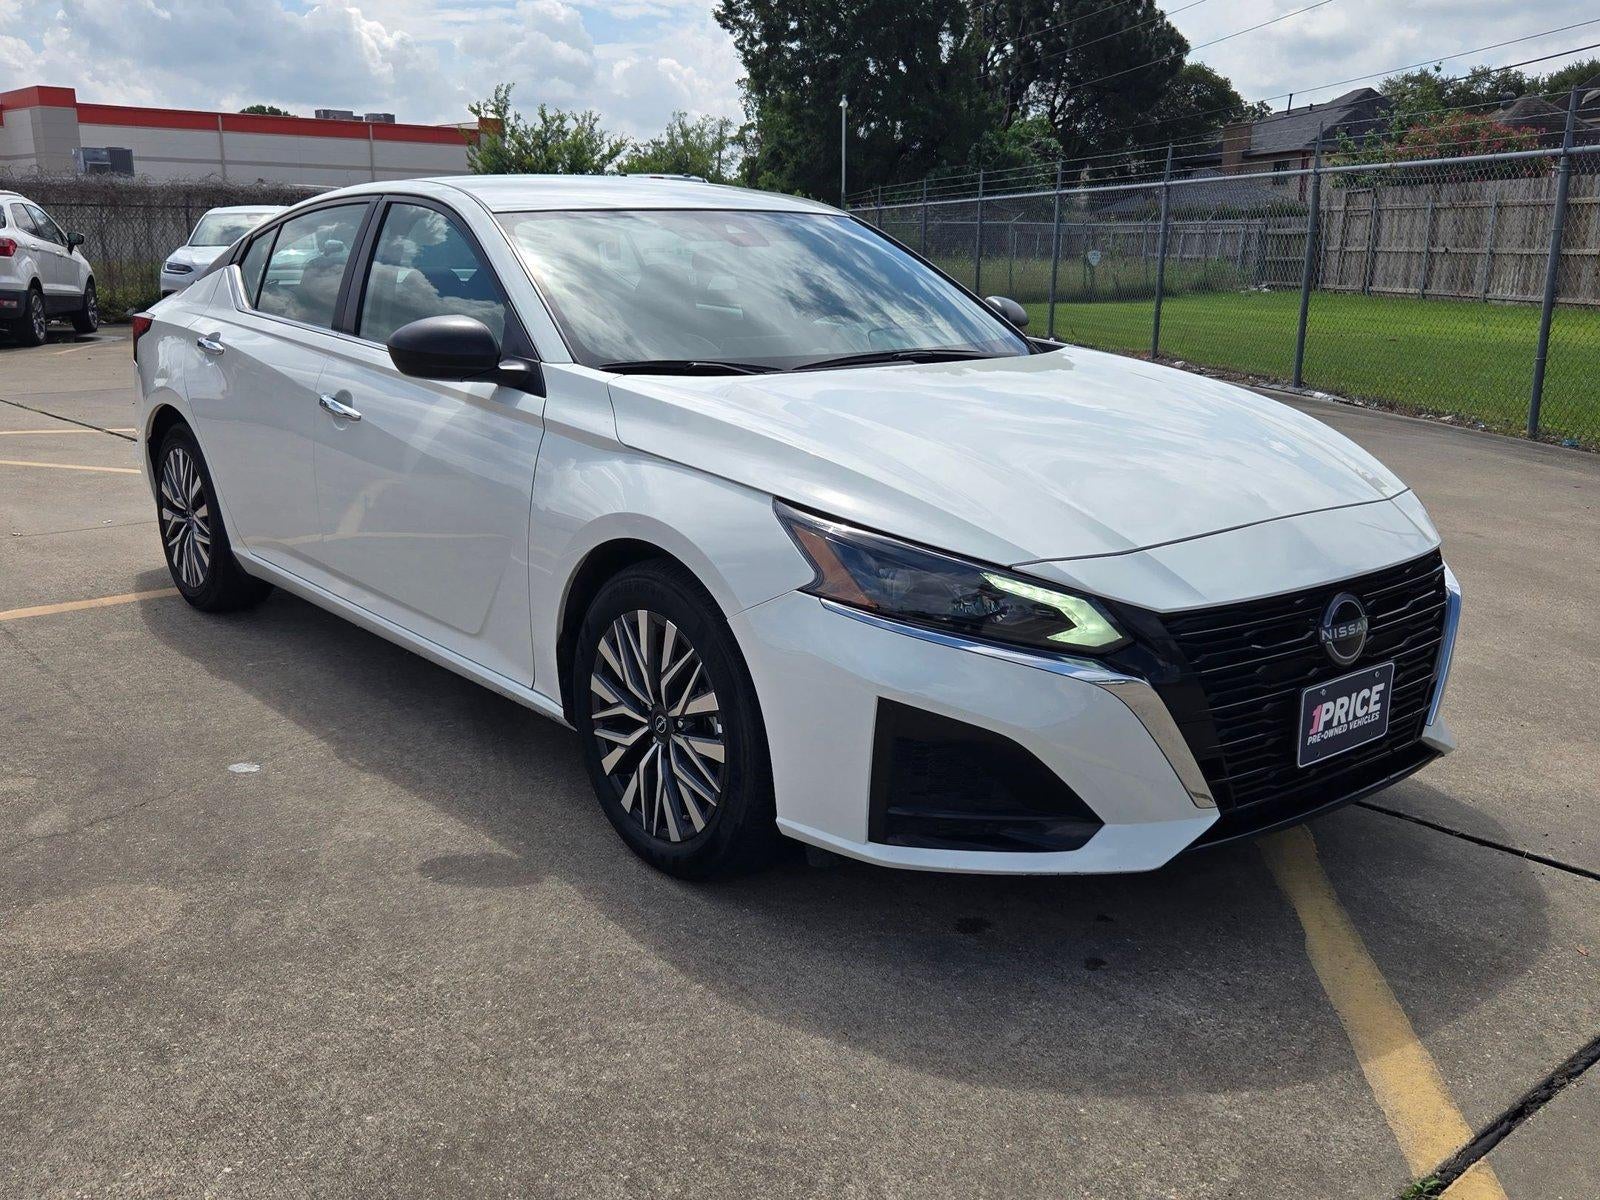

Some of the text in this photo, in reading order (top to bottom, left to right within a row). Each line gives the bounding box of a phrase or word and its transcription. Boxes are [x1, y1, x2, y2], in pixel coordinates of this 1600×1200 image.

[1321, 617, 1368, 640] NISSAN
[1307, 711, 1380, 746] PRE-OWNED VEHICLES
